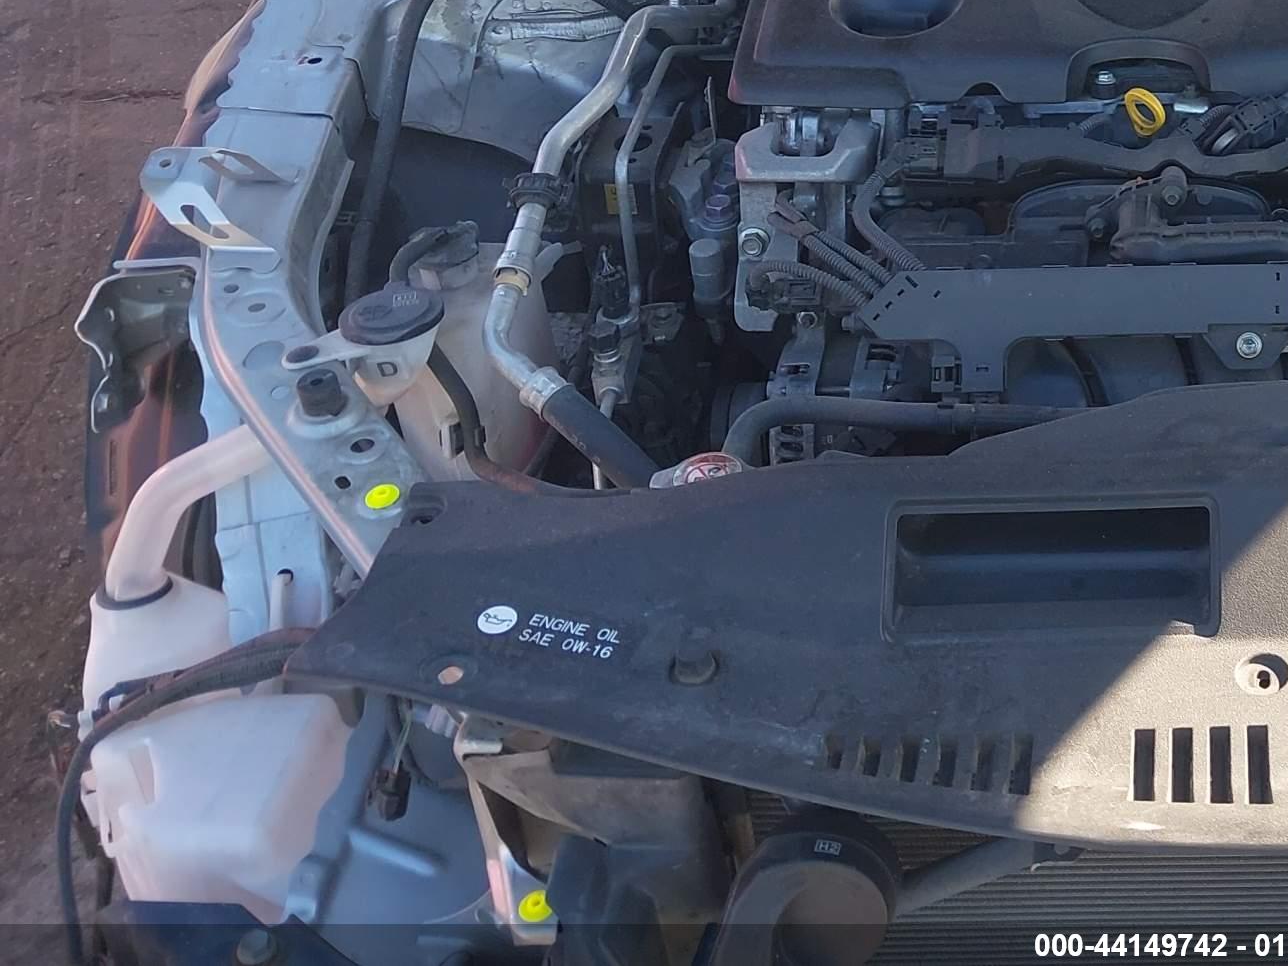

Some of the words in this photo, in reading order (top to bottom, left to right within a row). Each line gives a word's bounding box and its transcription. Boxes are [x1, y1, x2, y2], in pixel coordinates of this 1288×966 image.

[518, 628, 555, 647] SAE
[561, 638, 613, 659] 0W-16
[529, 613, 590, 636] ENGINE
[597, 628, 620, 644] OIL
